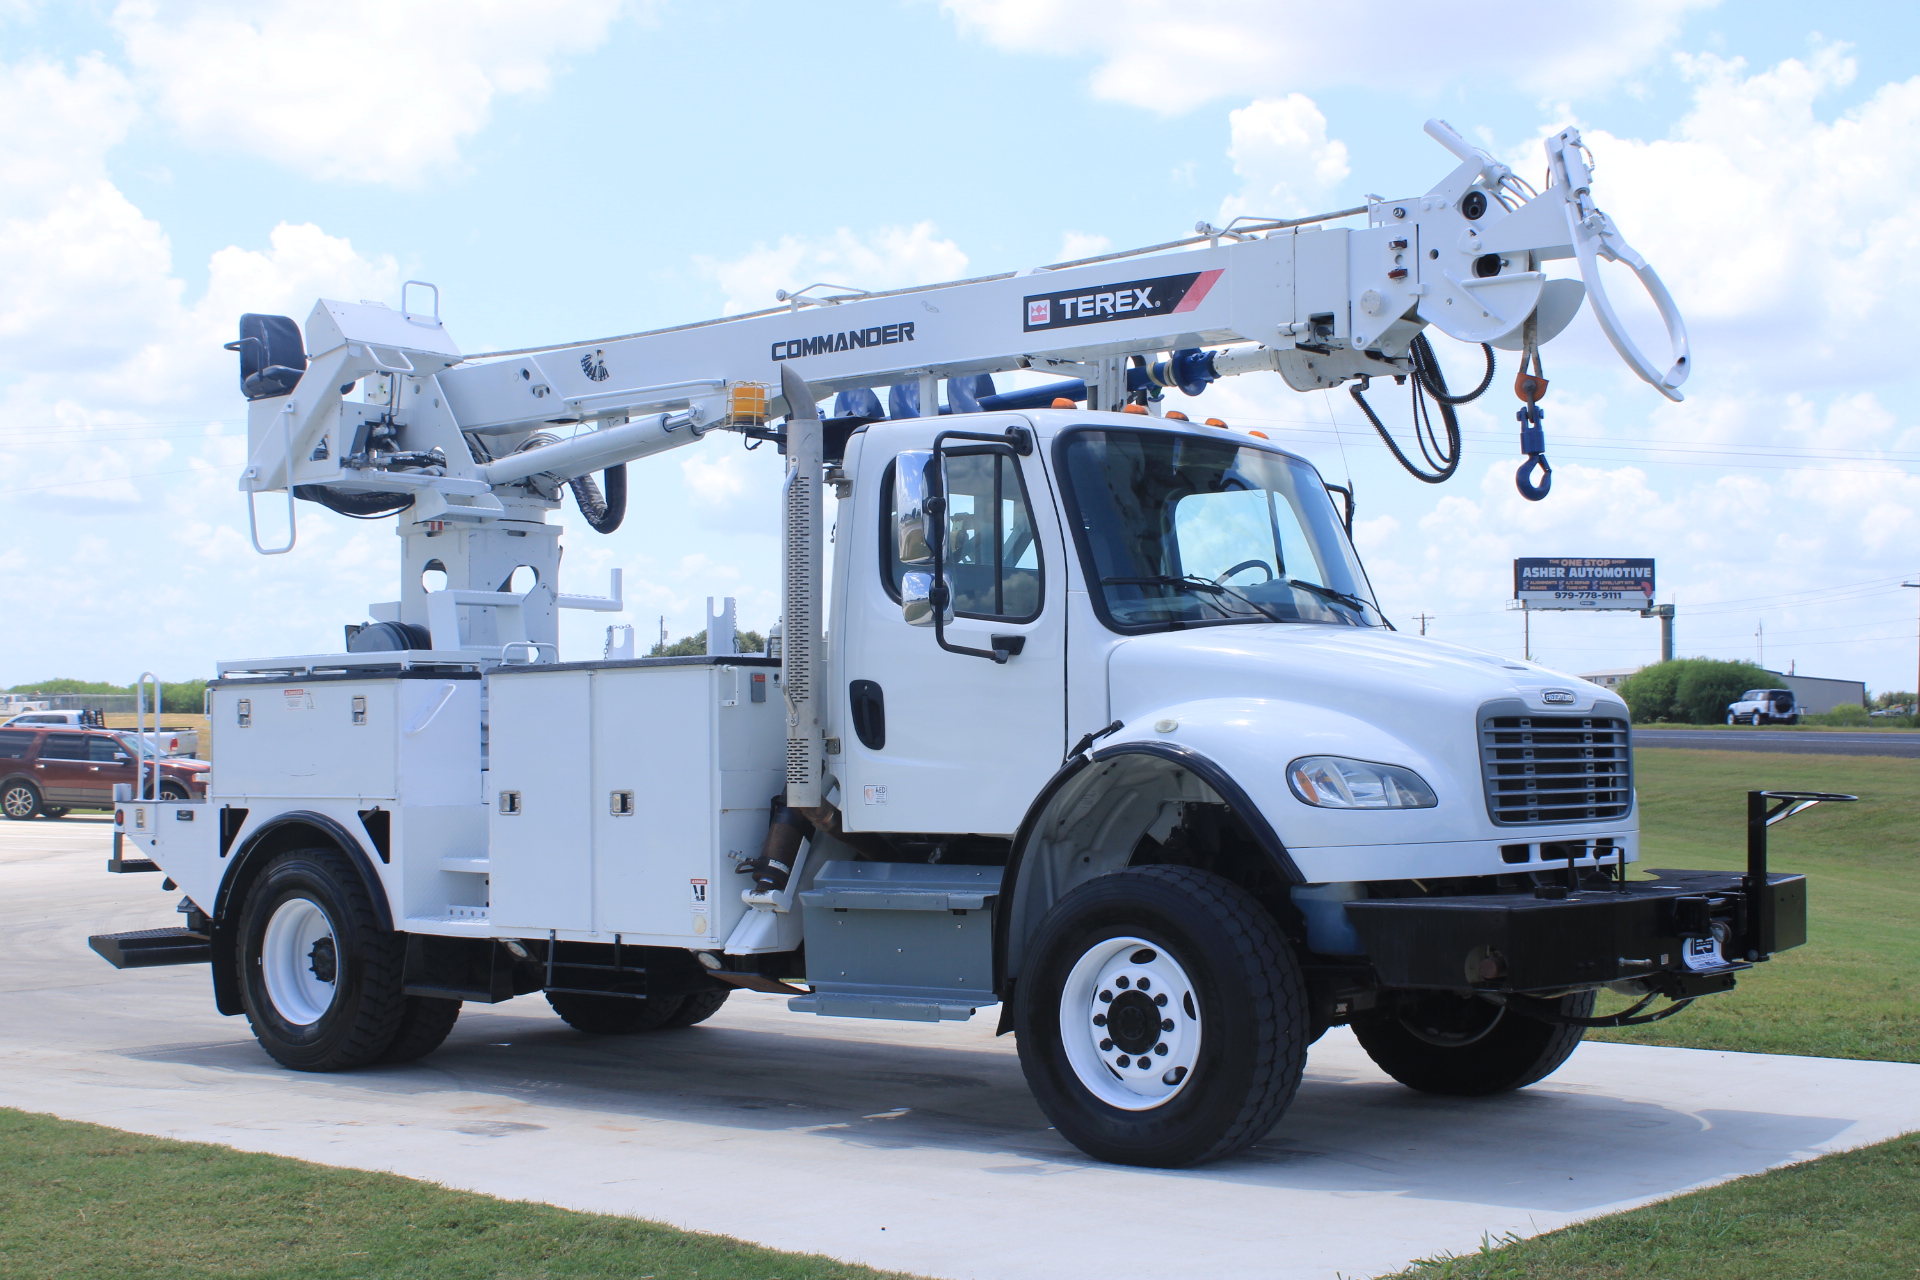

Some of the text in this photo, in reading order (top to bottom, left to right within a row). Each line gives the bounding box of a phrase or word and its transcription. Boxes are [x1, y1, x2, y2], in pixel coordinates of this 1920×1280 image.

[1059, 286, 1153, 320] TEREX
[771, 321, 915, 362] COMMANDER
[1522, 567, 1651, 578] ASHER AUTOMOTIVE
